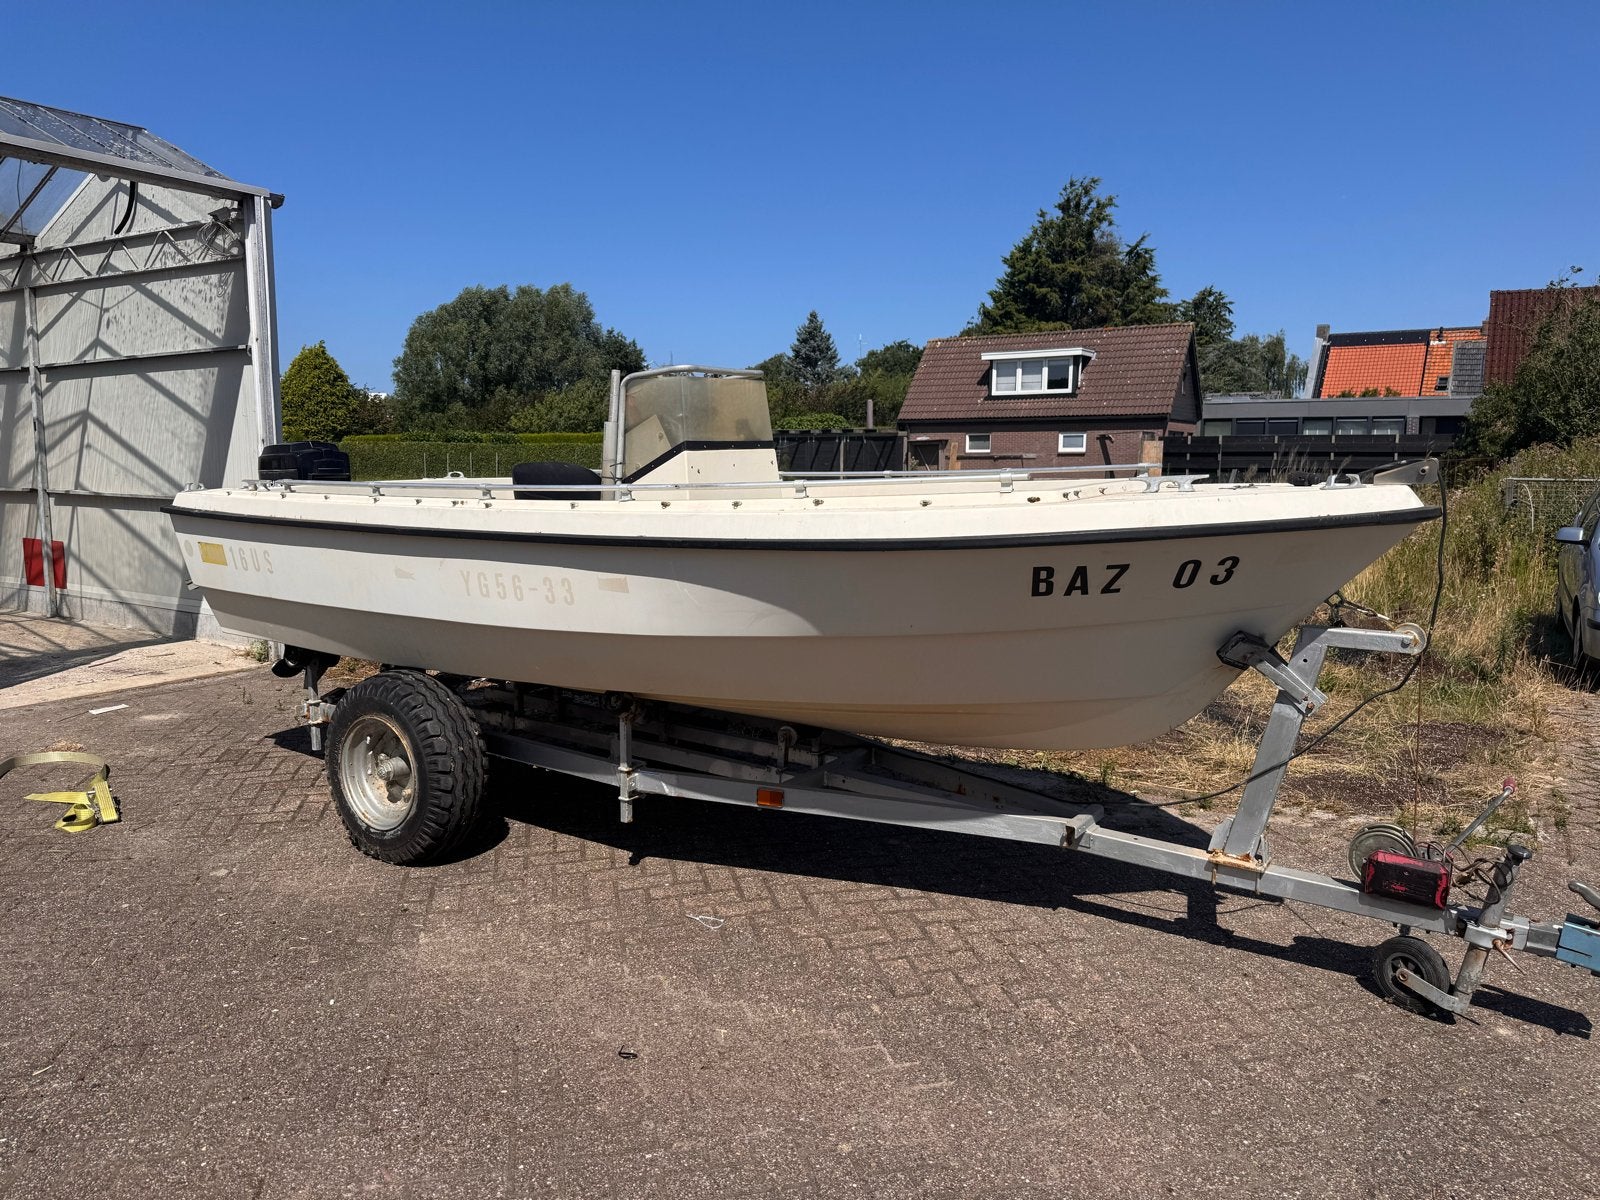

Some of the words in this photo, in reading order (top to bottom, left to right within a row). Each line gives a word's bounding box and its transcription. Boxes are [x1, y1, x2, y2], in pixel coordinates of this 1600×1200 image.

[458, 569, 576, 606] YG56-33
[1031, 563, 1131, 597] BAZ
[1172, 555, 1241, 589] 03
